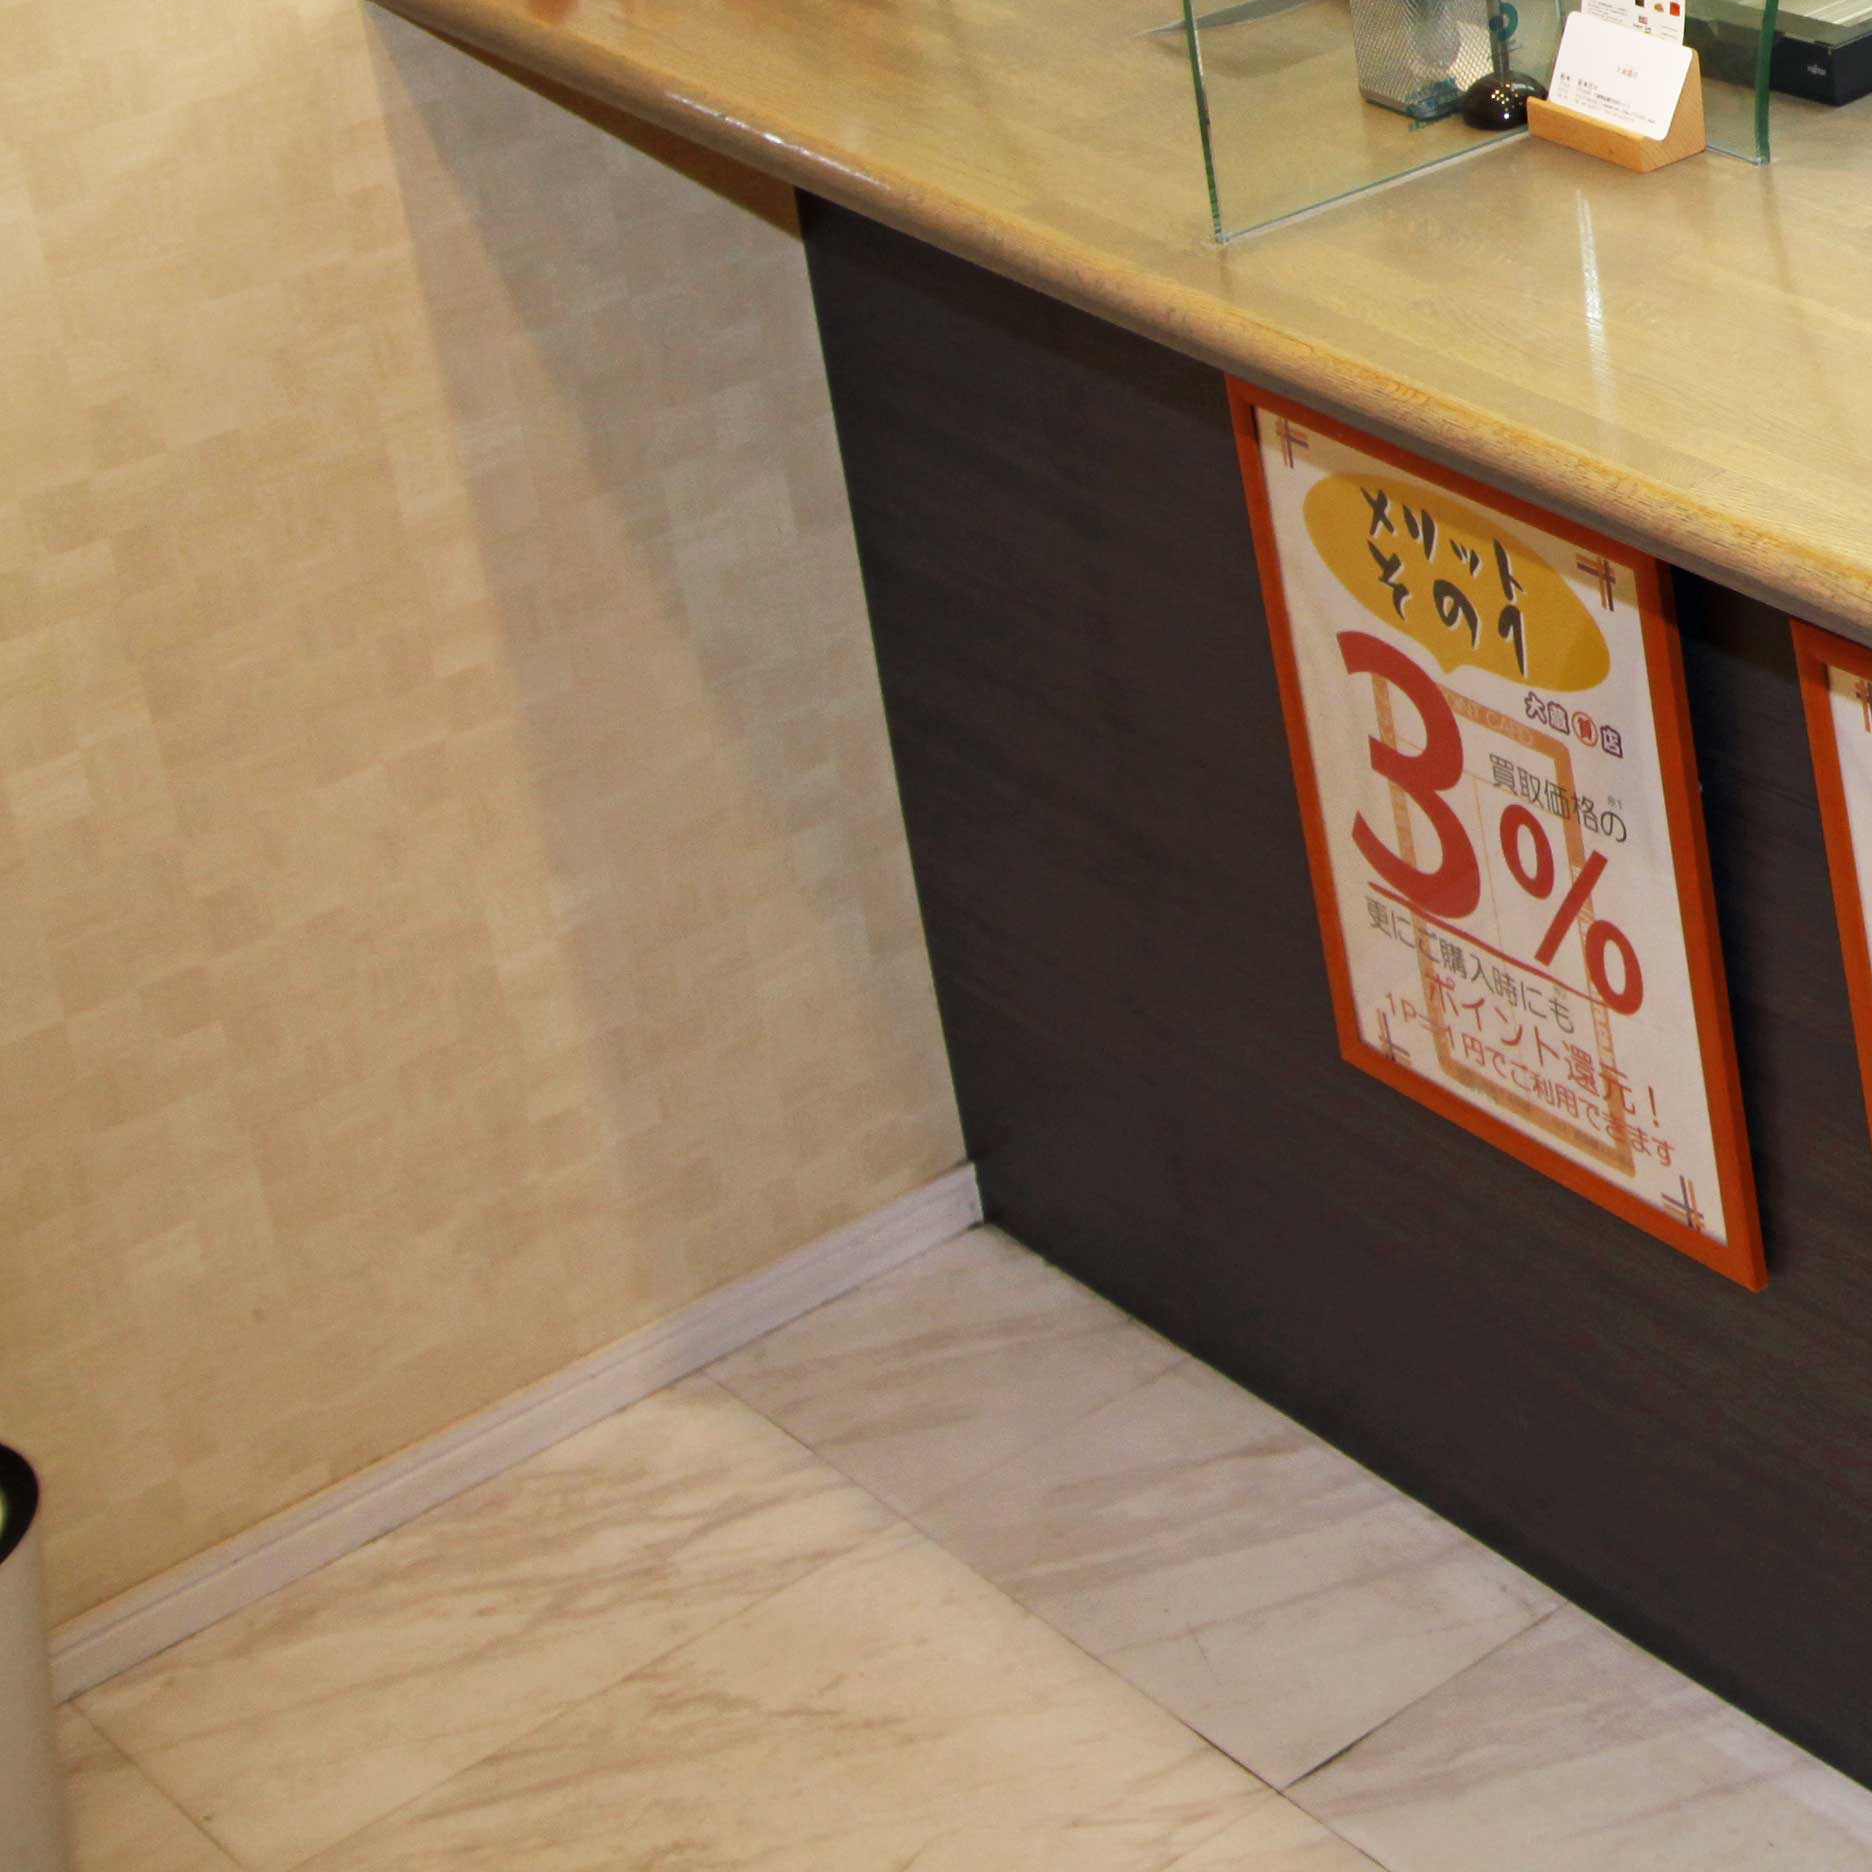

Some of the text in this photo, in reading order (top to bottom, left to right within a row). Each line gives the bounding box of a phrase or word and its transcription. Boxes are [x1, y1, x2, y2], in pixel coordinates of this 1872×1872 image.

[1361, 486, 1525, 592] メリット
[1336, 629, 1645, 1017] 3%
[1489, 753, 1627, 844] 買取価格の
[1366, 896, 1575, 1035] 更にご購入時にも
